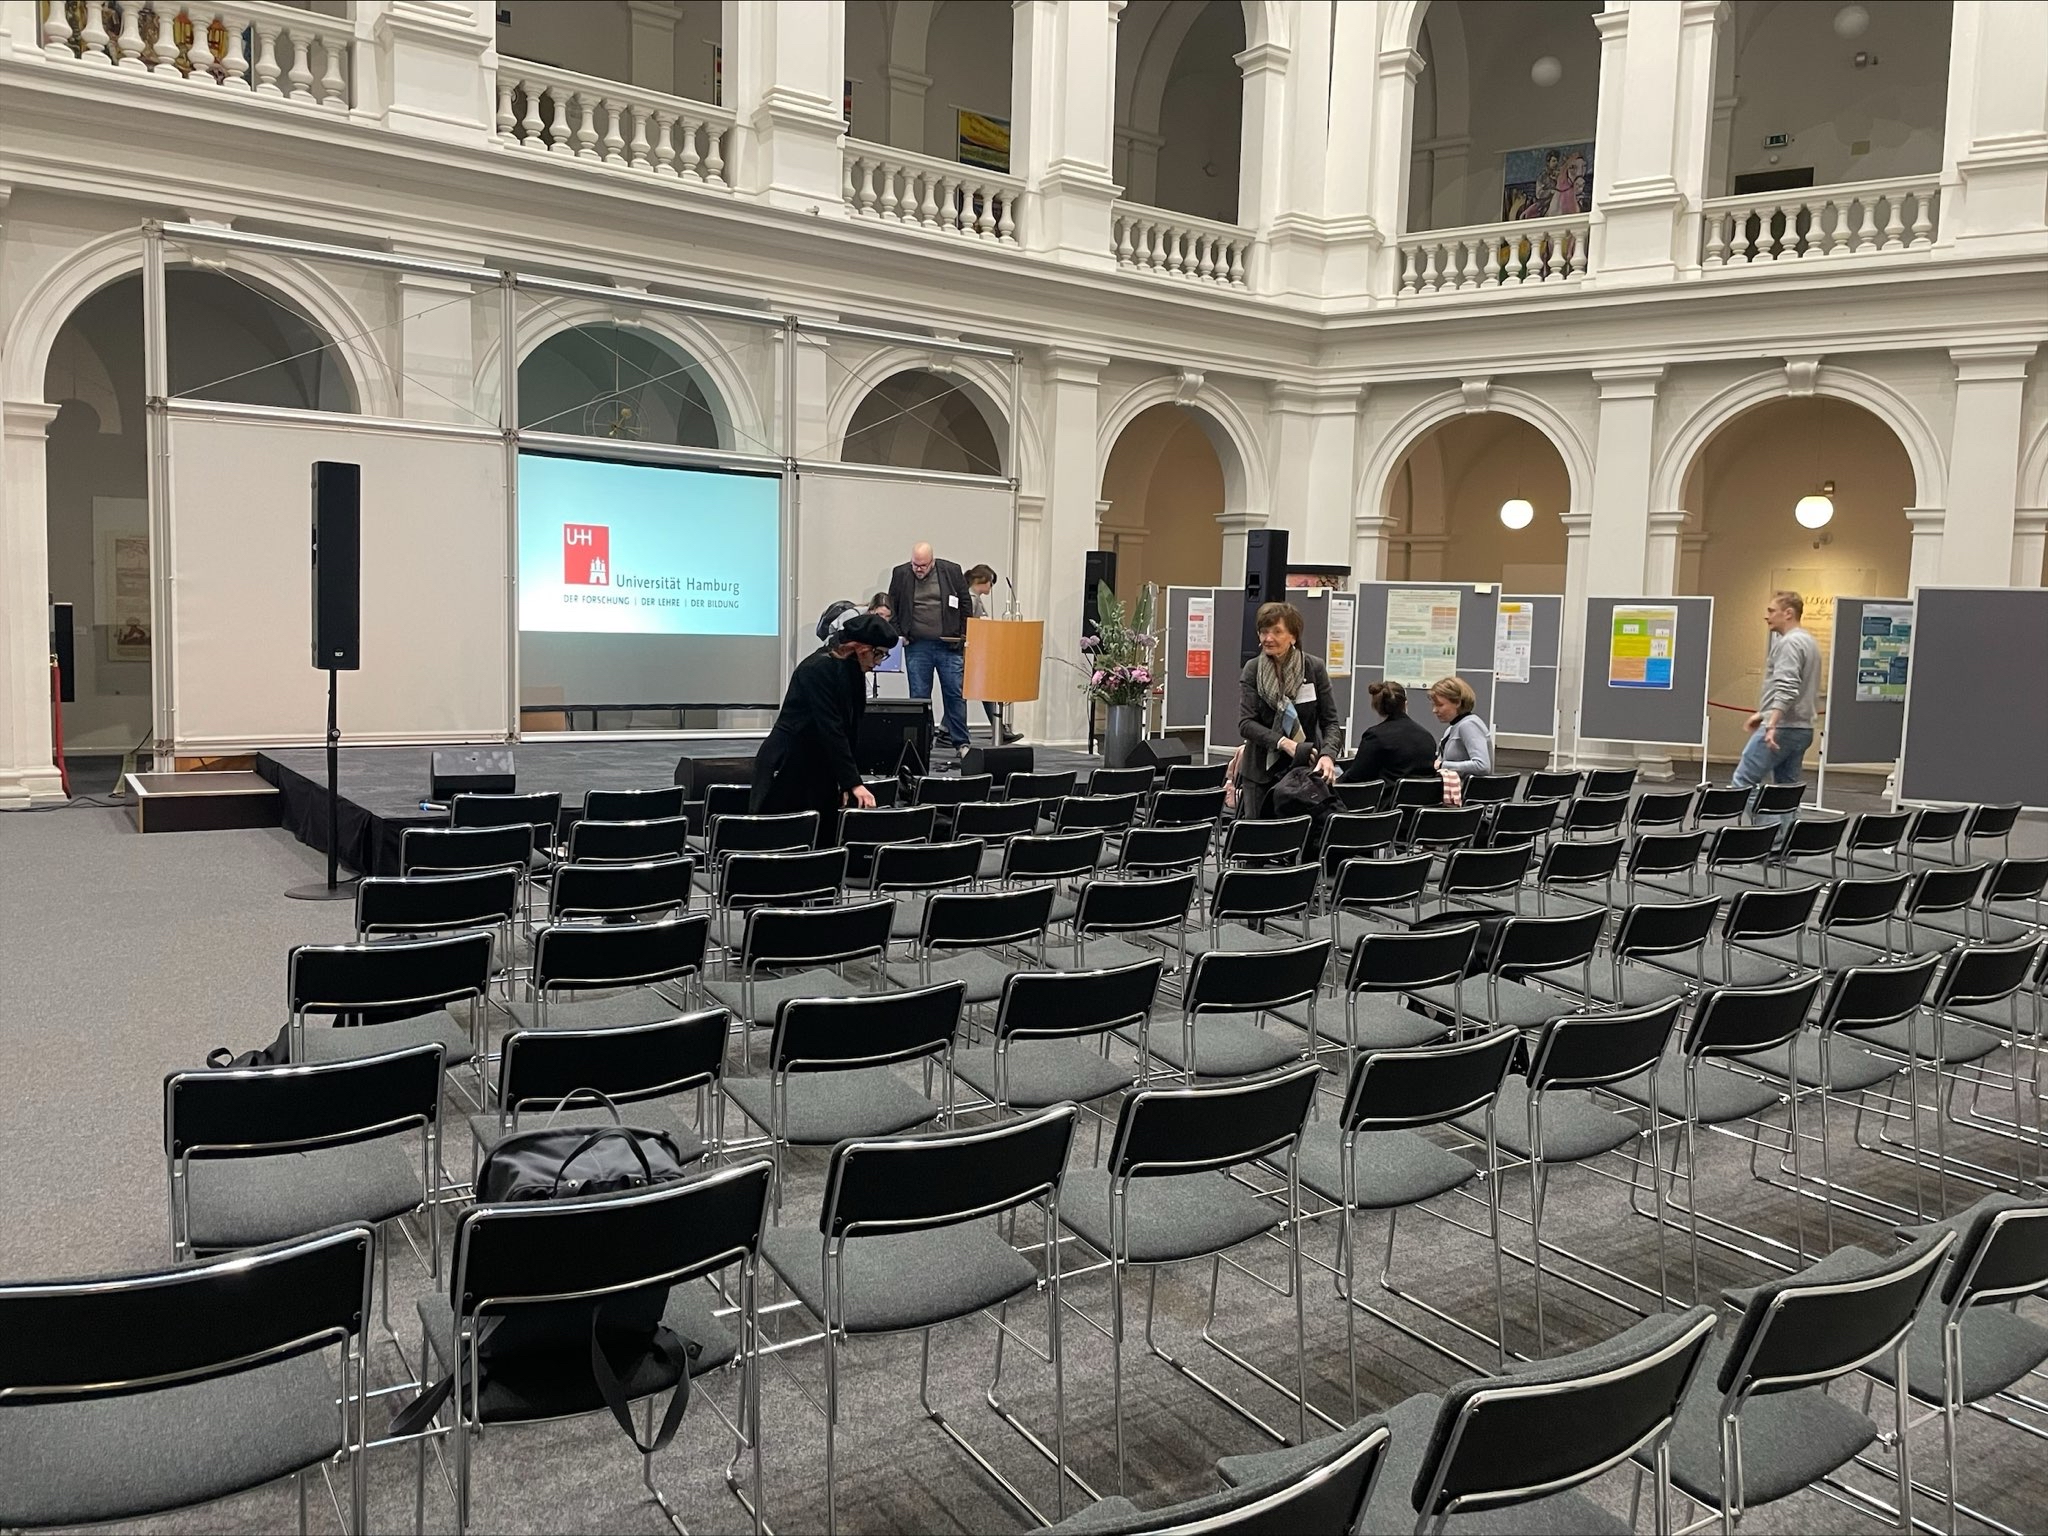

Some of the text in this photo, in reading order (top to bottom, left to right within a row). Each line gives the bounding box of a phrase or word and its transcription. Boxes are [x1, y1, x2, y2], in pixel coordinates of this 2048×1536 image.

[616, 574, 740, 596] Universität Hamburg
[563, 594, 739, 609] DER FORSCHUNG DER LEHRE DER BILDUNG
